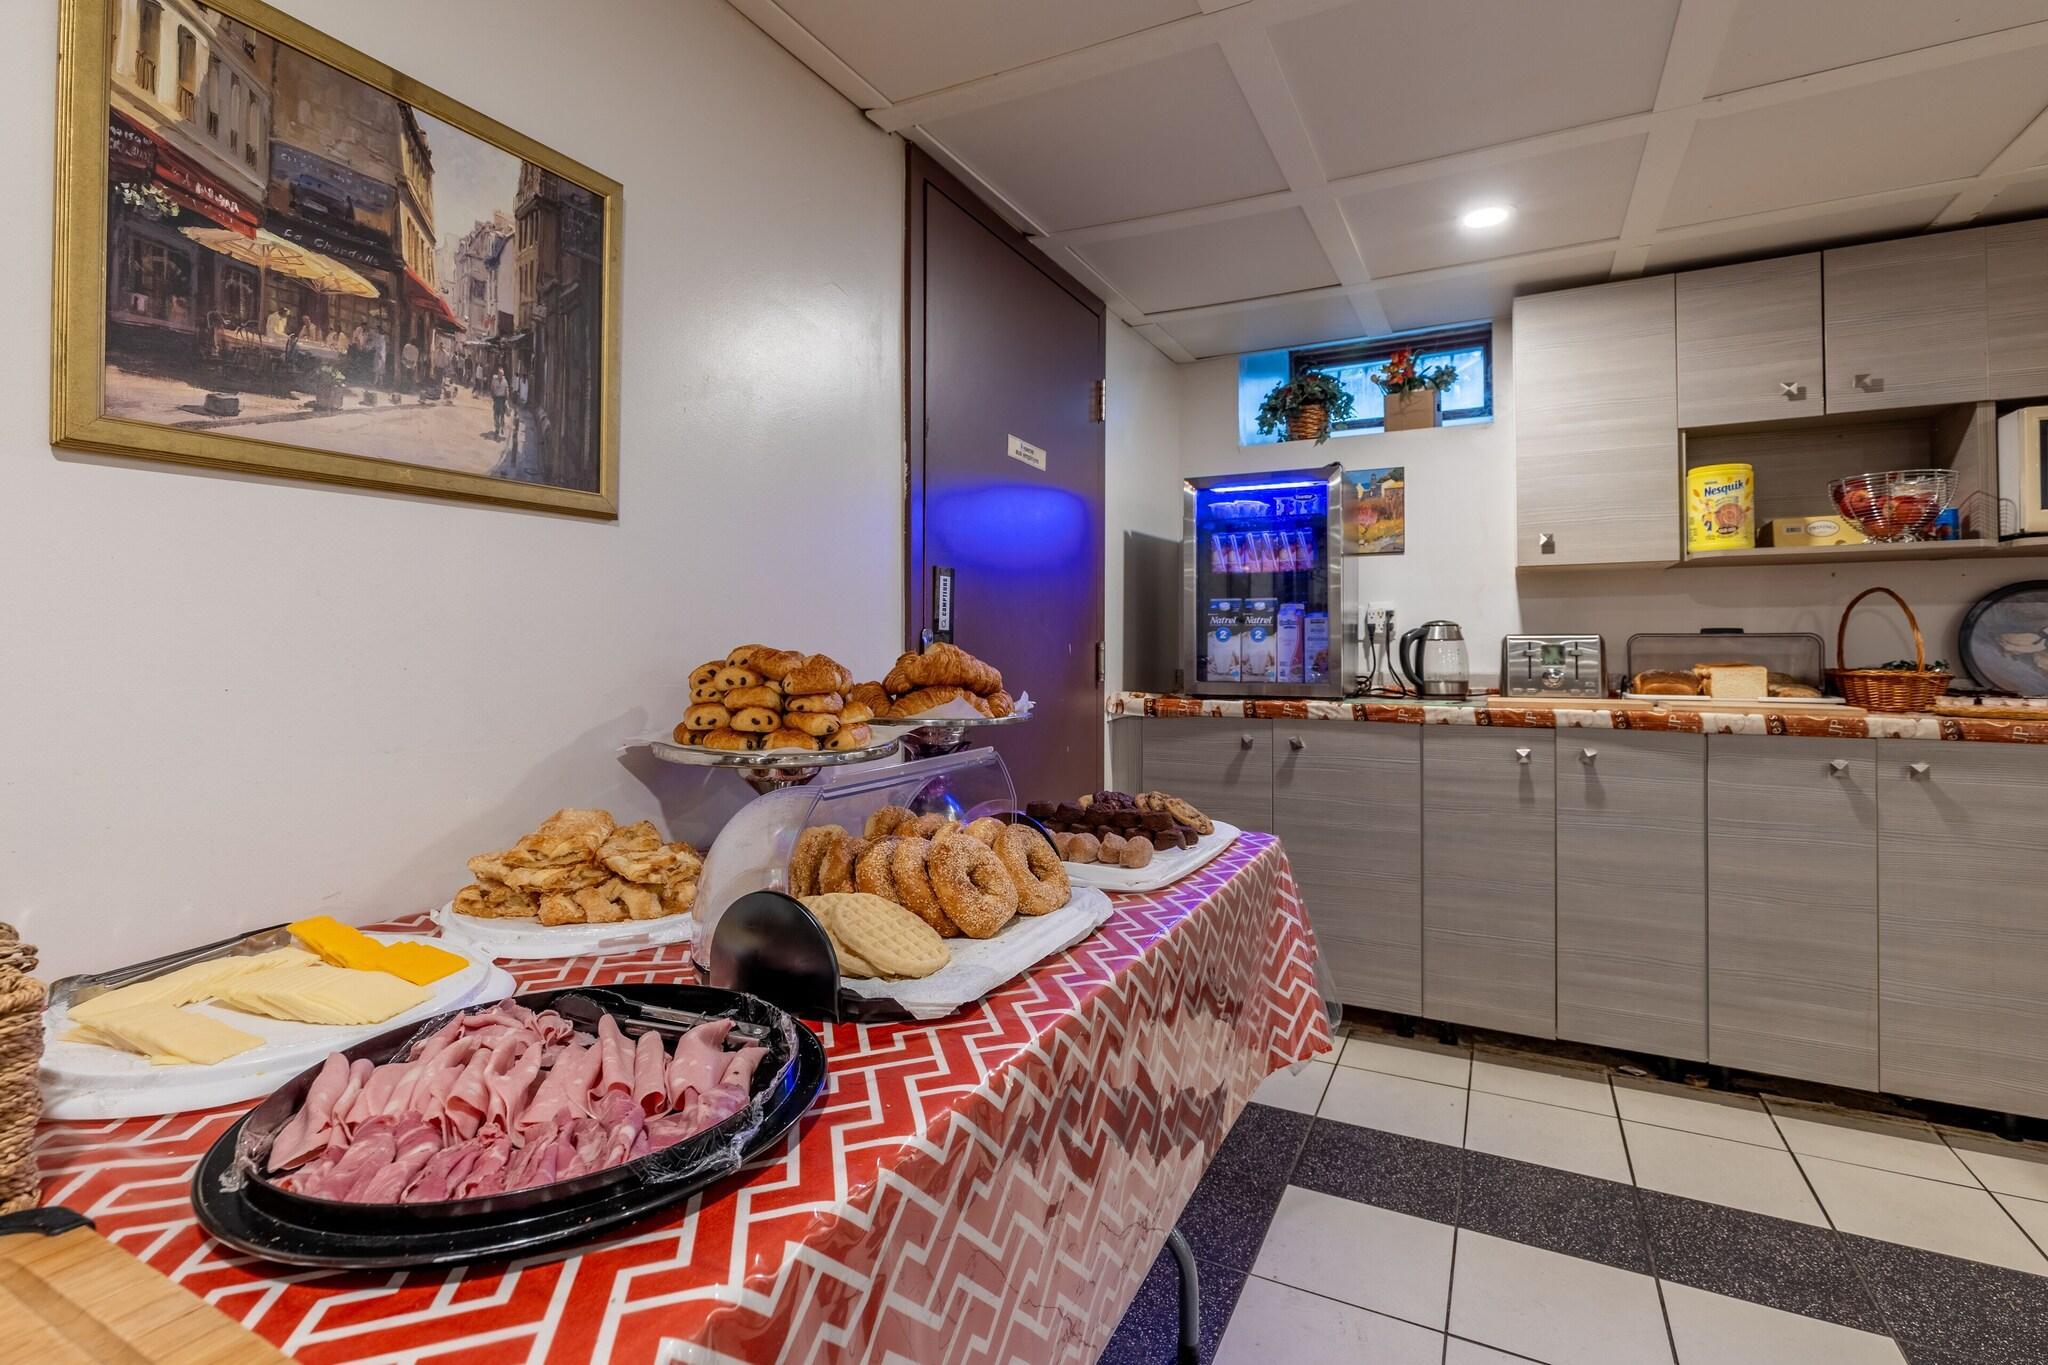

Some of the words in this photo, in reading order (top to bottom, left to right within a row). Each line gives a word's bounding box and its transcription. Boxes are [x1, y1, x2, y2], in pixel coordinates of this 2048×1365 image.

[1704, 480, 1744, 497] Nesquik
[1210, 616, 1238, 624] Natrel
[1245, 616, 1273, 624] Natrel
[1219, 630, 1226, 639] 2
[1254, 630, 1262, 639] 2
